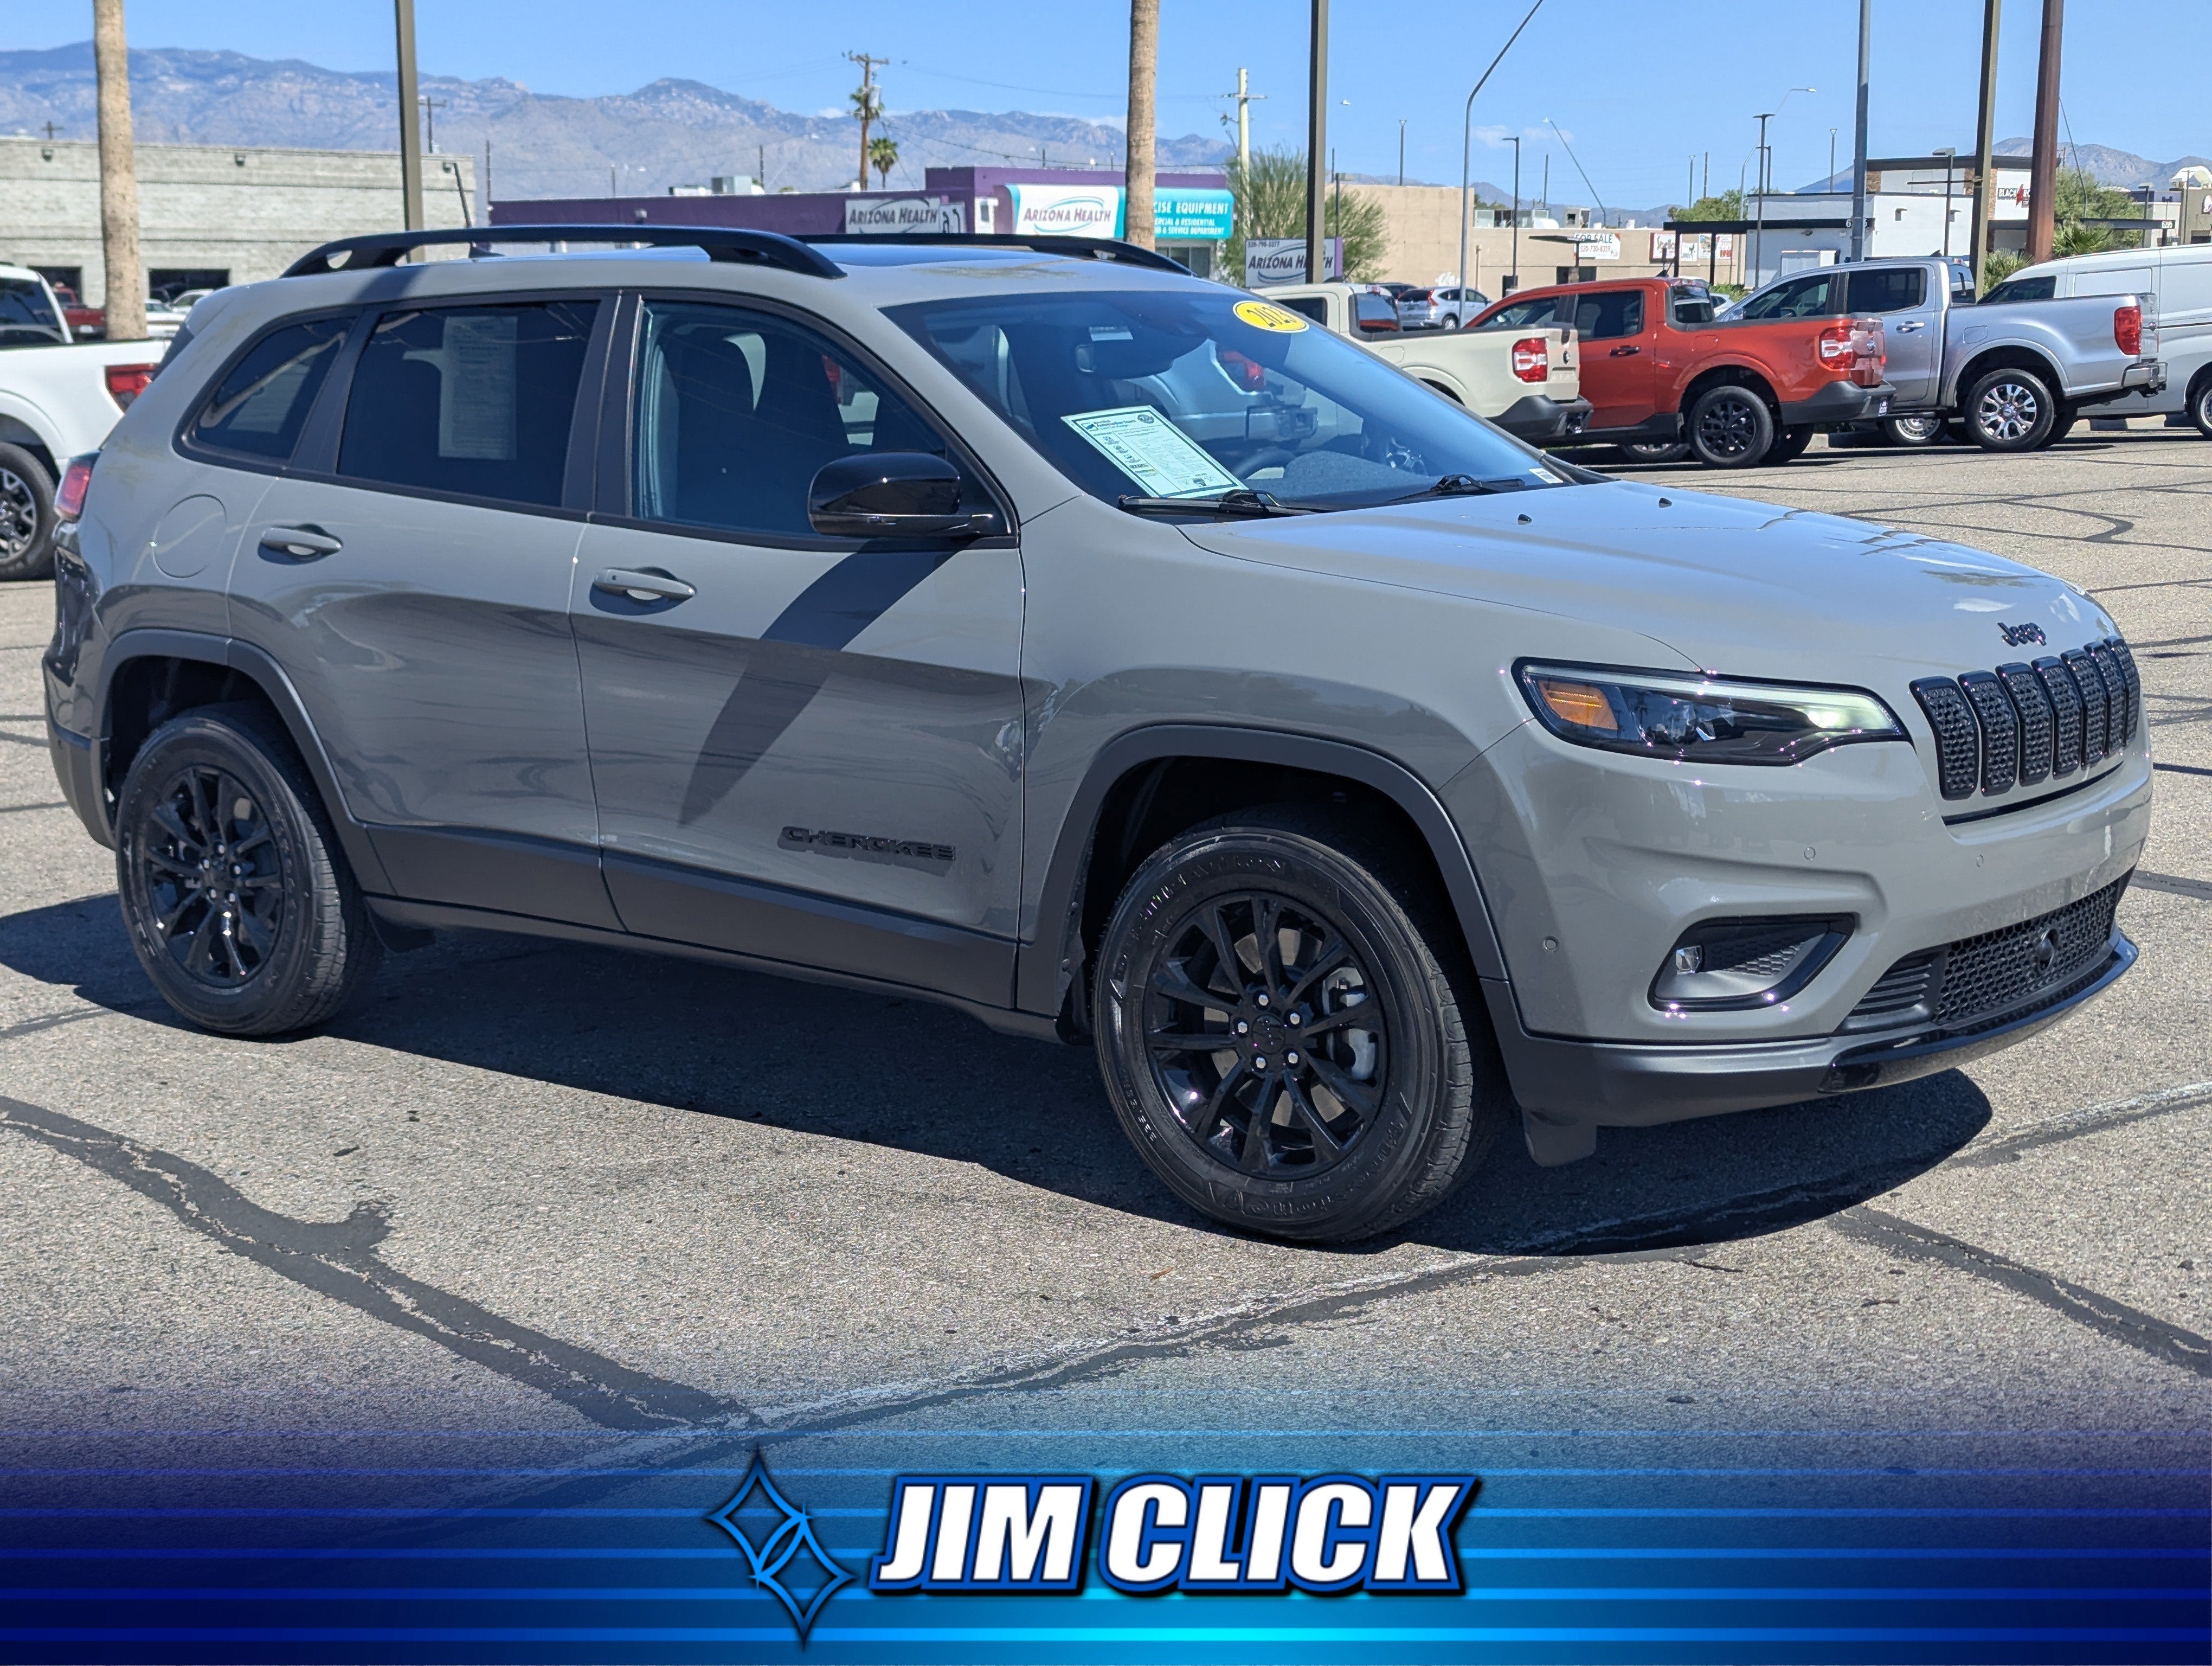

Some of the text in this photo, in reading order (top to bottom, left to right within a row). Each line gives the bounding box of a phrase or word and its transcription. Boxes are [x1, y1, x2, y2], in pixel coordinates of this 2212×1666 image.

[1998, 189, 2017, 197] BLACK
[1024, 208, 1111, 222] ARIZONA HEALTH
[1154, 202, 1229, 214] CISE EQUIPMENT
[849, 208, 937, 225] ARIZONA HEALTH
[1594, 234, 1612, 243] SALE
[1248, 255, 1293, 269] ARIZONA
[1997, 622, 2047, 647] Jeep
[779, 826, 956, 861] CHEROKEE
